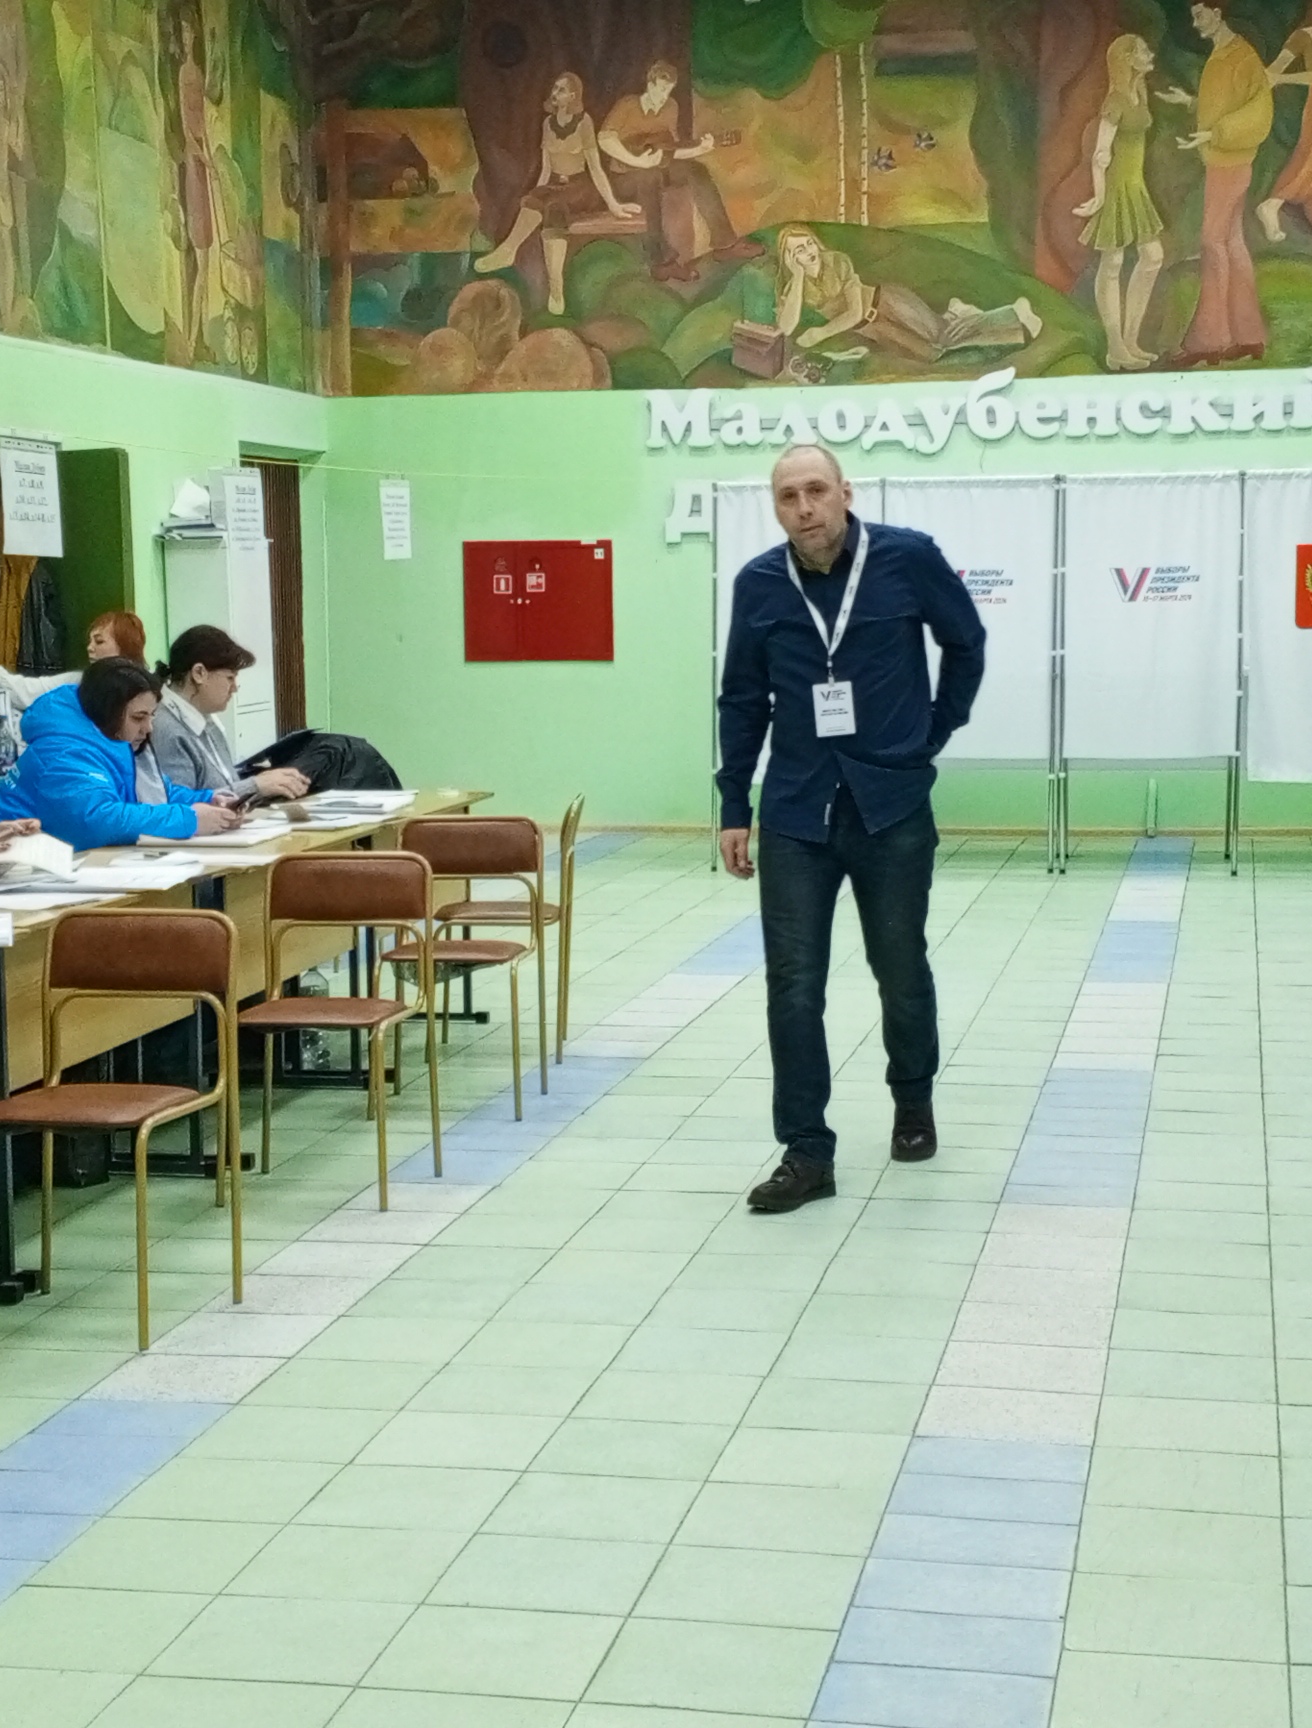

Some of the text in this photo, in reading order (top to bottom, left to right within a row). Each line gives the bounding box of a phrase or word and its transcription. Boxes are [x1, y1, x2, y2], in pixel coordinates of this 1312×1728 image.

[1154, 565, 1190, 575] ВЫБОРЫ
[1150, 574, 1201, 584] ПРЕЗИДЕНТА
[967, 588, 992, 596] ОССИИ
[1146, 585, 1179, 594] РОССИИ
